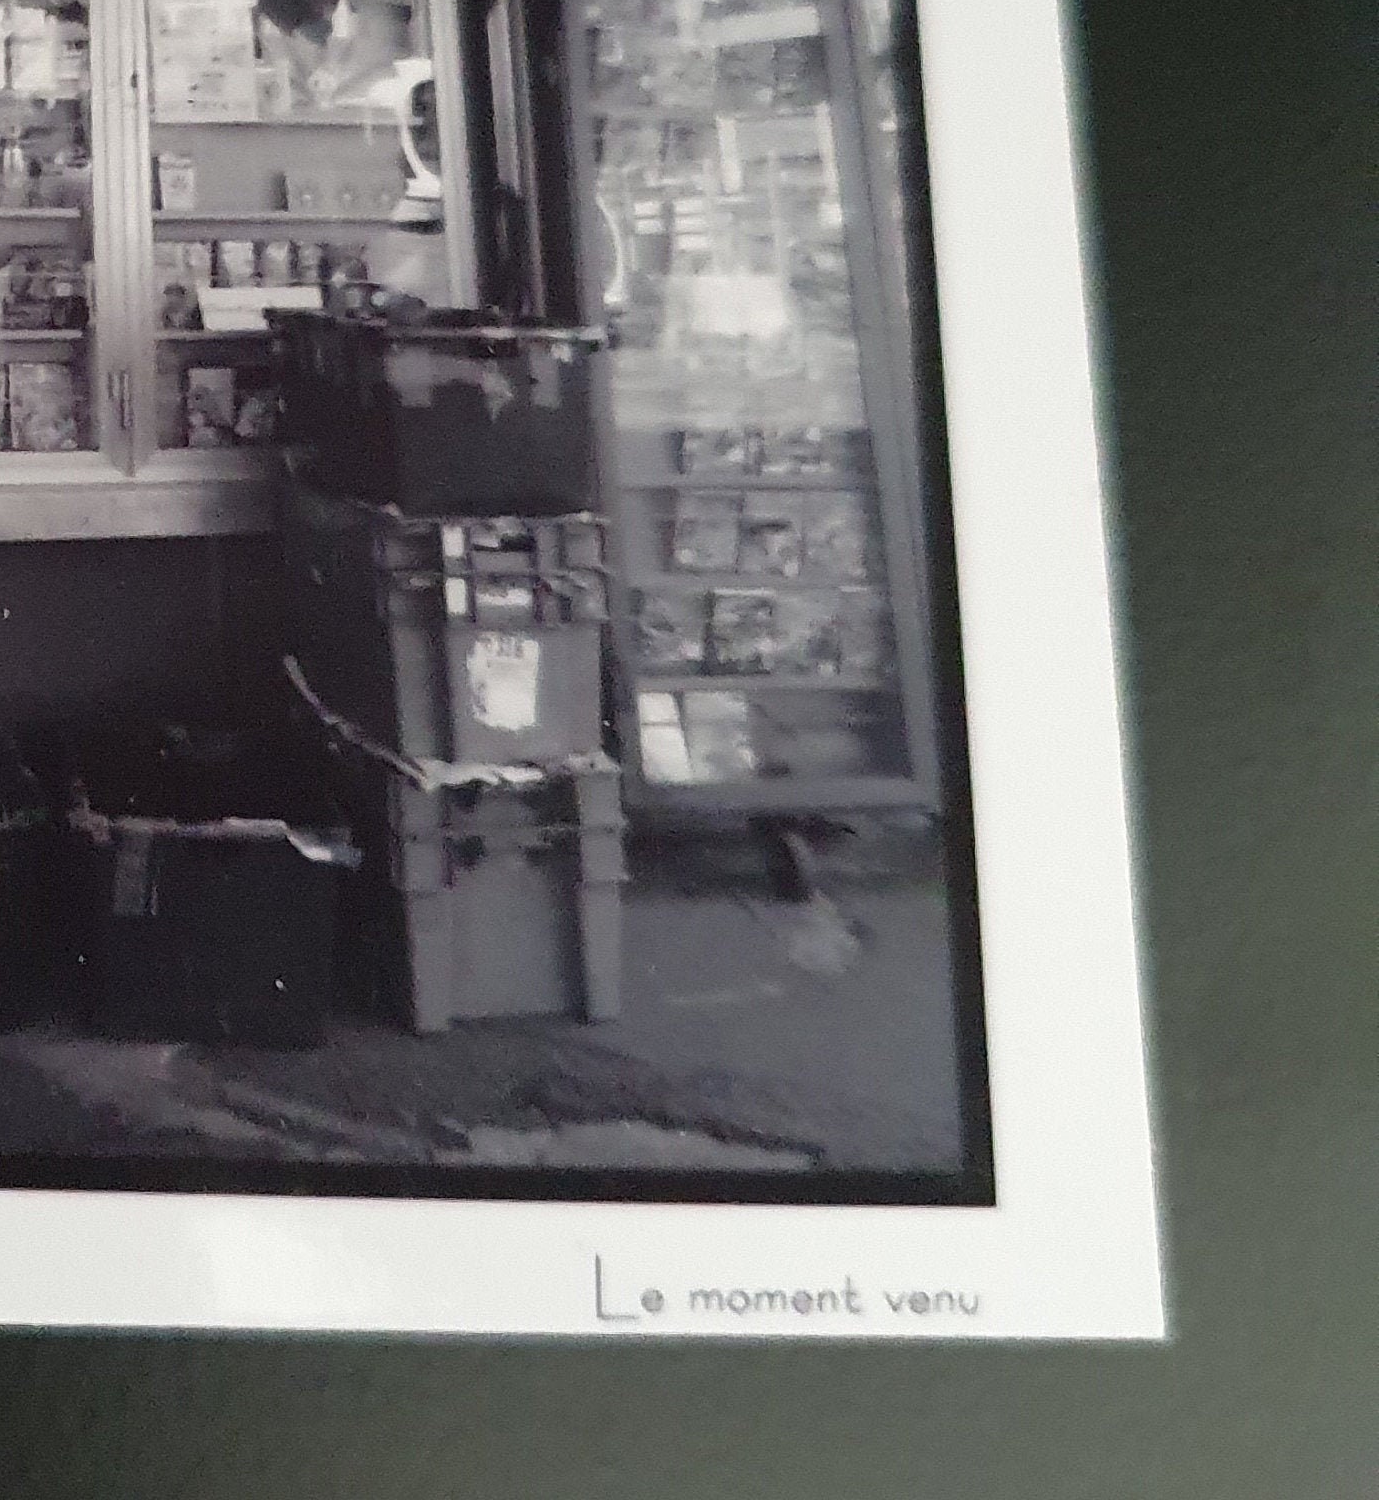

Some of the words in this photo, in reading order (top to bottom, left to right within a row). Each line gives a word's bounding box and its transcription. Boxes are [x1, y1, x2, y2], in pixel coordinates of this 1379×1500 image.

[595, 1253, 665, 1322] Le
[688, 1274, 863, 1316] moment
[883, 1288, 979, 1316] venu
